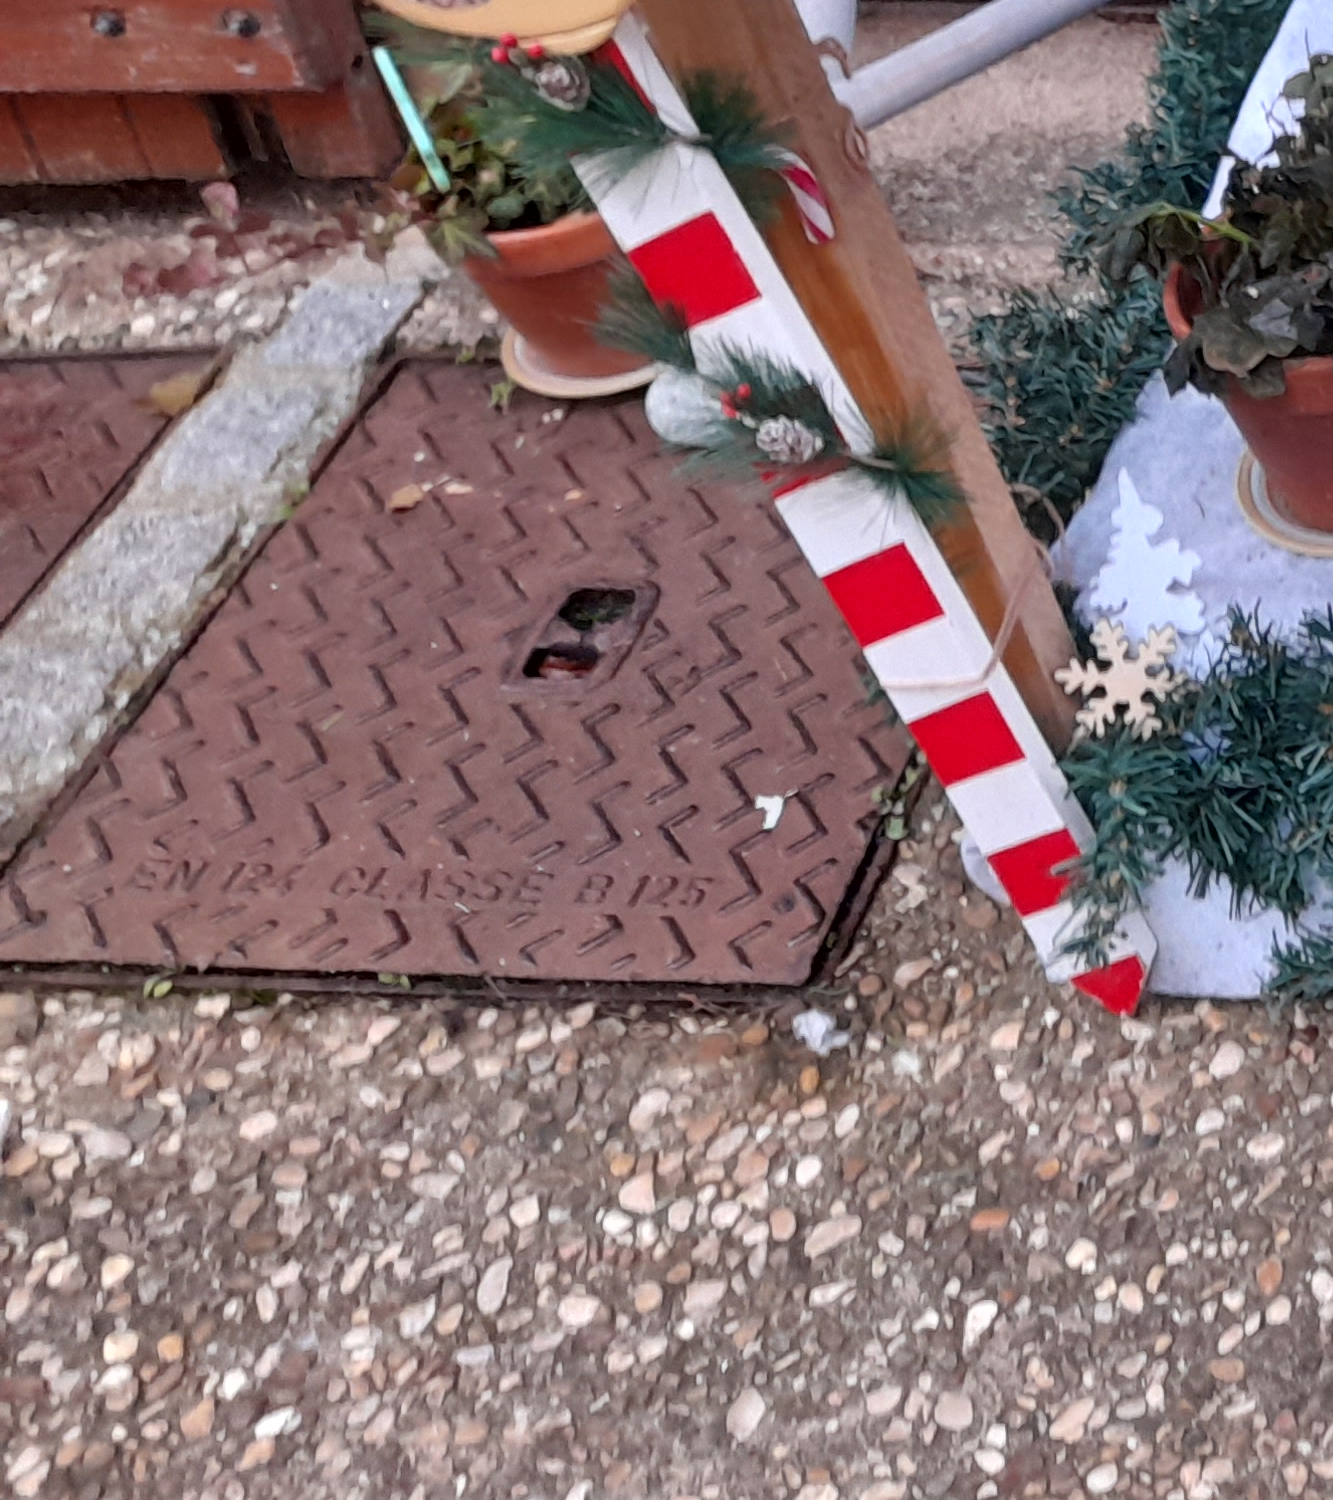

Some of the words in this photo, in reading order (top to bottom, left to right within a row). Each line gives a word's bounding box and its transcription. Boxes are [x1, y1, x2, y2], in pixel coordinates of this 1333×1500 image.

[127, 857, 207, 892] EN
[330, 864, 556, 906] CLASSE
[628, 874, 714, 908] 125
